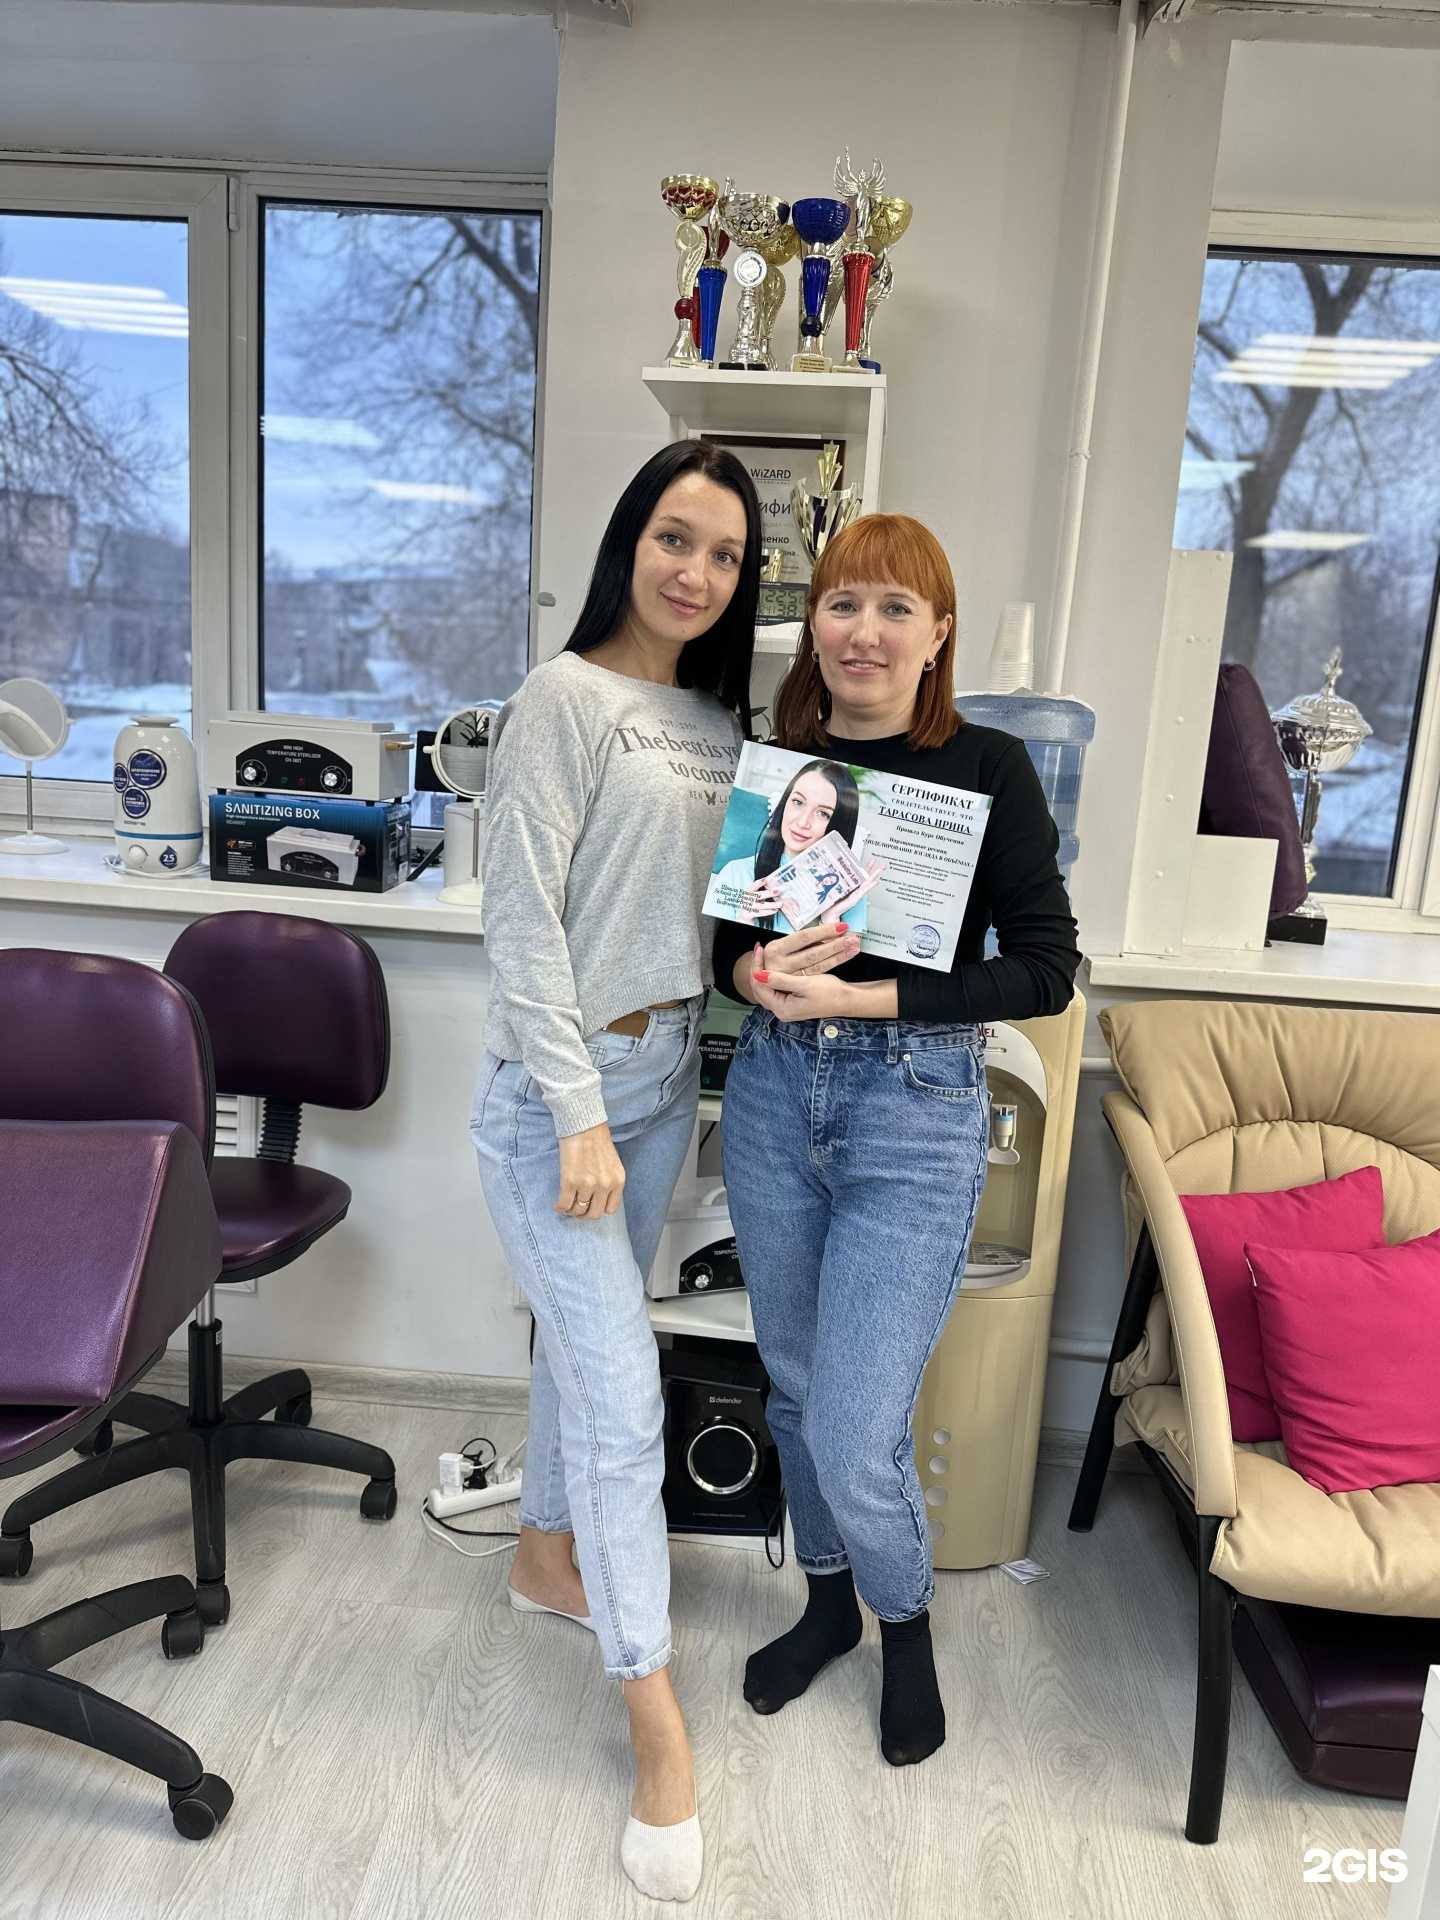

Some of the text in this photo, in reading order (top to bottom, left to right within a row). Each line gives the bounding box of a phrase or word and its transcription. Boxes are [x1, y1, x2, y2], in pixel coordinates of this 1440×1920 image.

[615, 727, 667, 753] The
[661, 730, 707, 757] best
[668, 760, 737, 784] to come
[891, 783, 974, 810] СЕРТИФИКАТ
[225, 802, 293, 818] SANITIZING
[295, 807, 320, 820] BOX
[880, 805, 970, 834] ТАРАСОВА ИРИНА
[984, 1028, 998, 1038] EL
